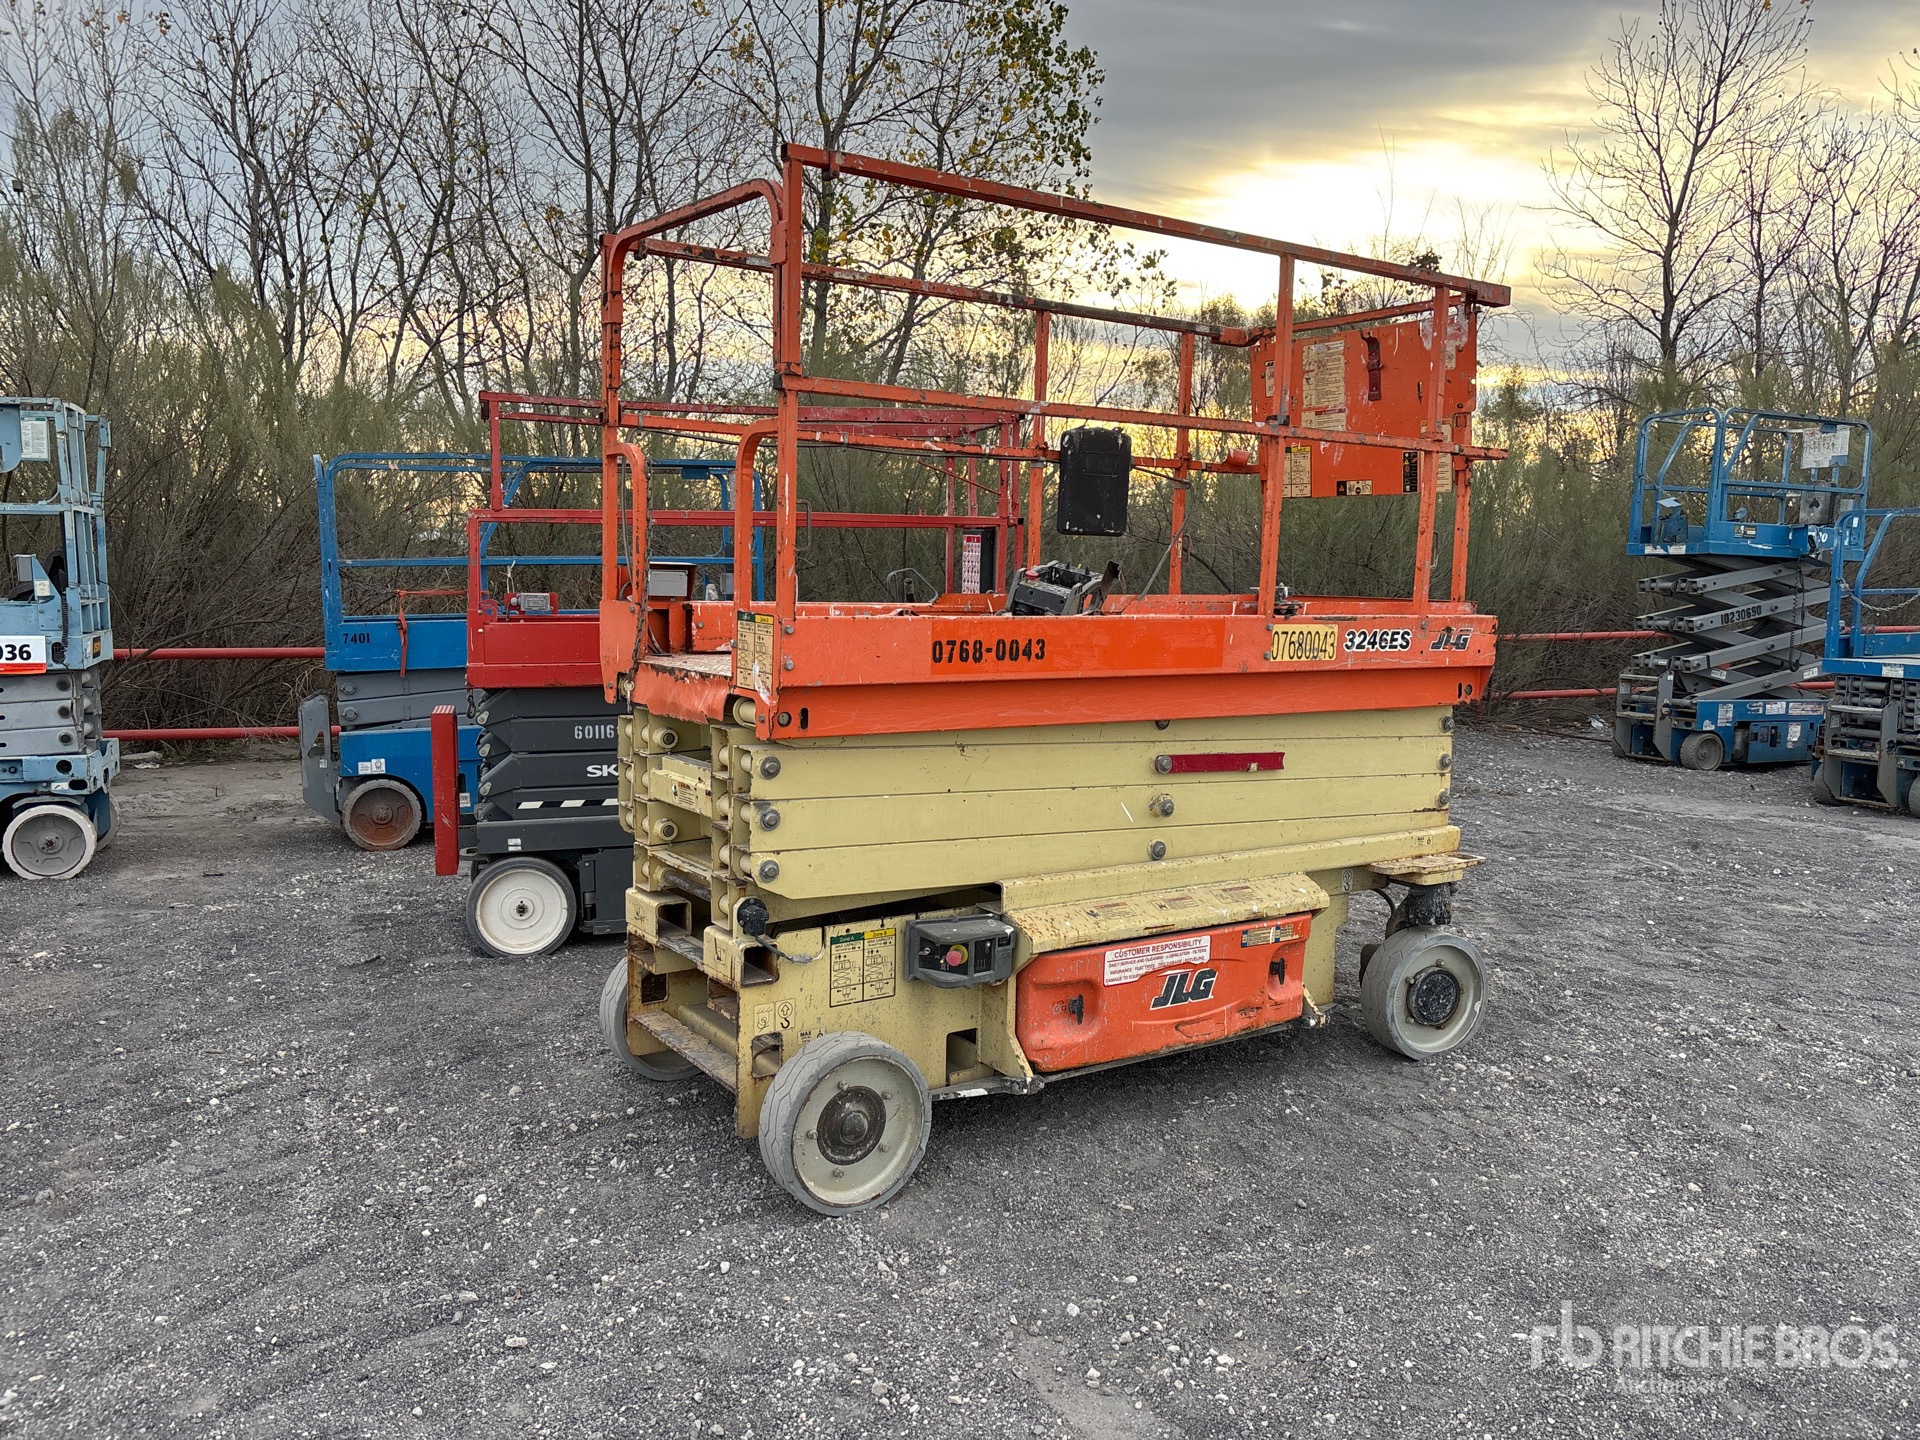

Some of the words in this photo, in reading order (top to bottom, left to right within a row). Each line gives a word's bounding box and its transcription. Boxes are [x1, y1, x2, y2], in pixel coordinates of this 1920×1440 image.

[1721, 605, 1762, 625] 10230690
[0, 643, 32, 661] 36
[932, 638, 1046, 663] 0768-0043
[1271, 630, 1336, 660] 07680043
[1343, 628, 1411, 652] 3246ES
[1114, 946, 1150, 959] CUSTOMER
[1151, 938, 1202, 953] RESPONSIBILITY
[1150, 968, 1218, 1010] JLG
